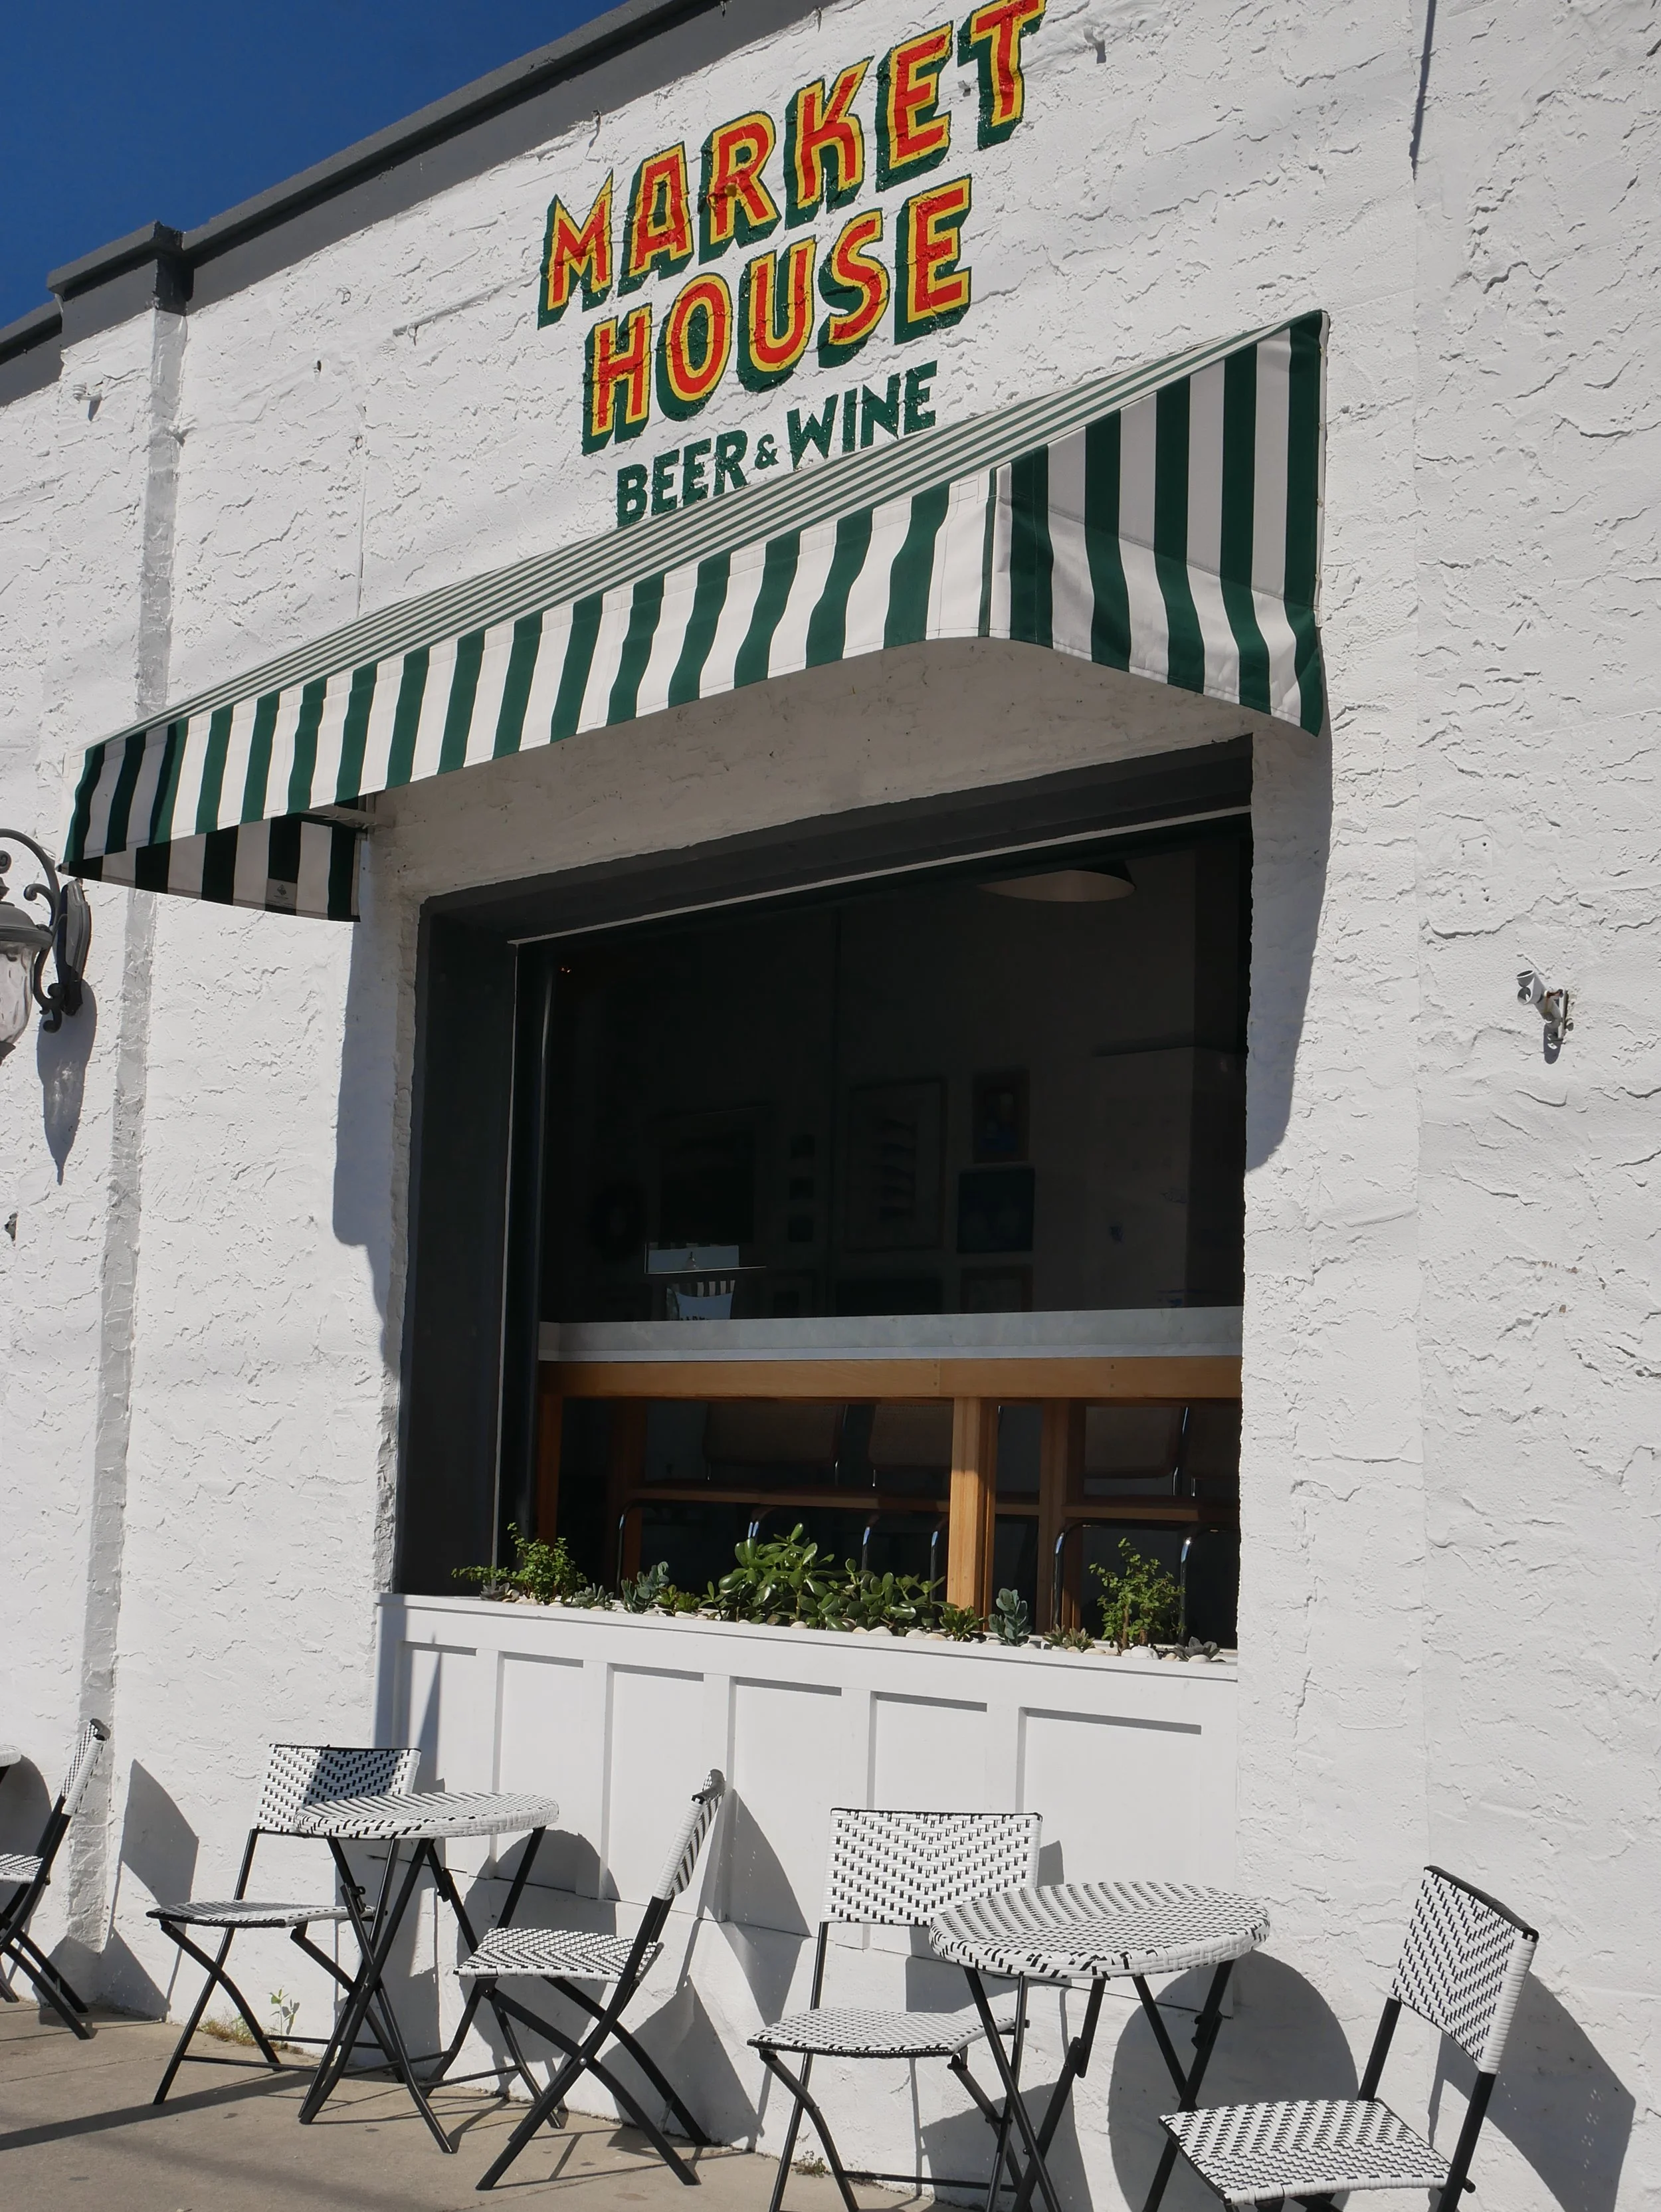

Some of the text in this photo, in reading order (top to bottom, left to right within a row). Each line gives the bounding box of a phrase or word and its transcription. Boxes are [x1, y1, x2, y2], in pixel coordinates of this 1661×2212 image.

[537, 0, 1046, 330] MARKET
[581, 174, 973, 455] HOUSE
[616, 360, 938, 528] BEER & WINE
